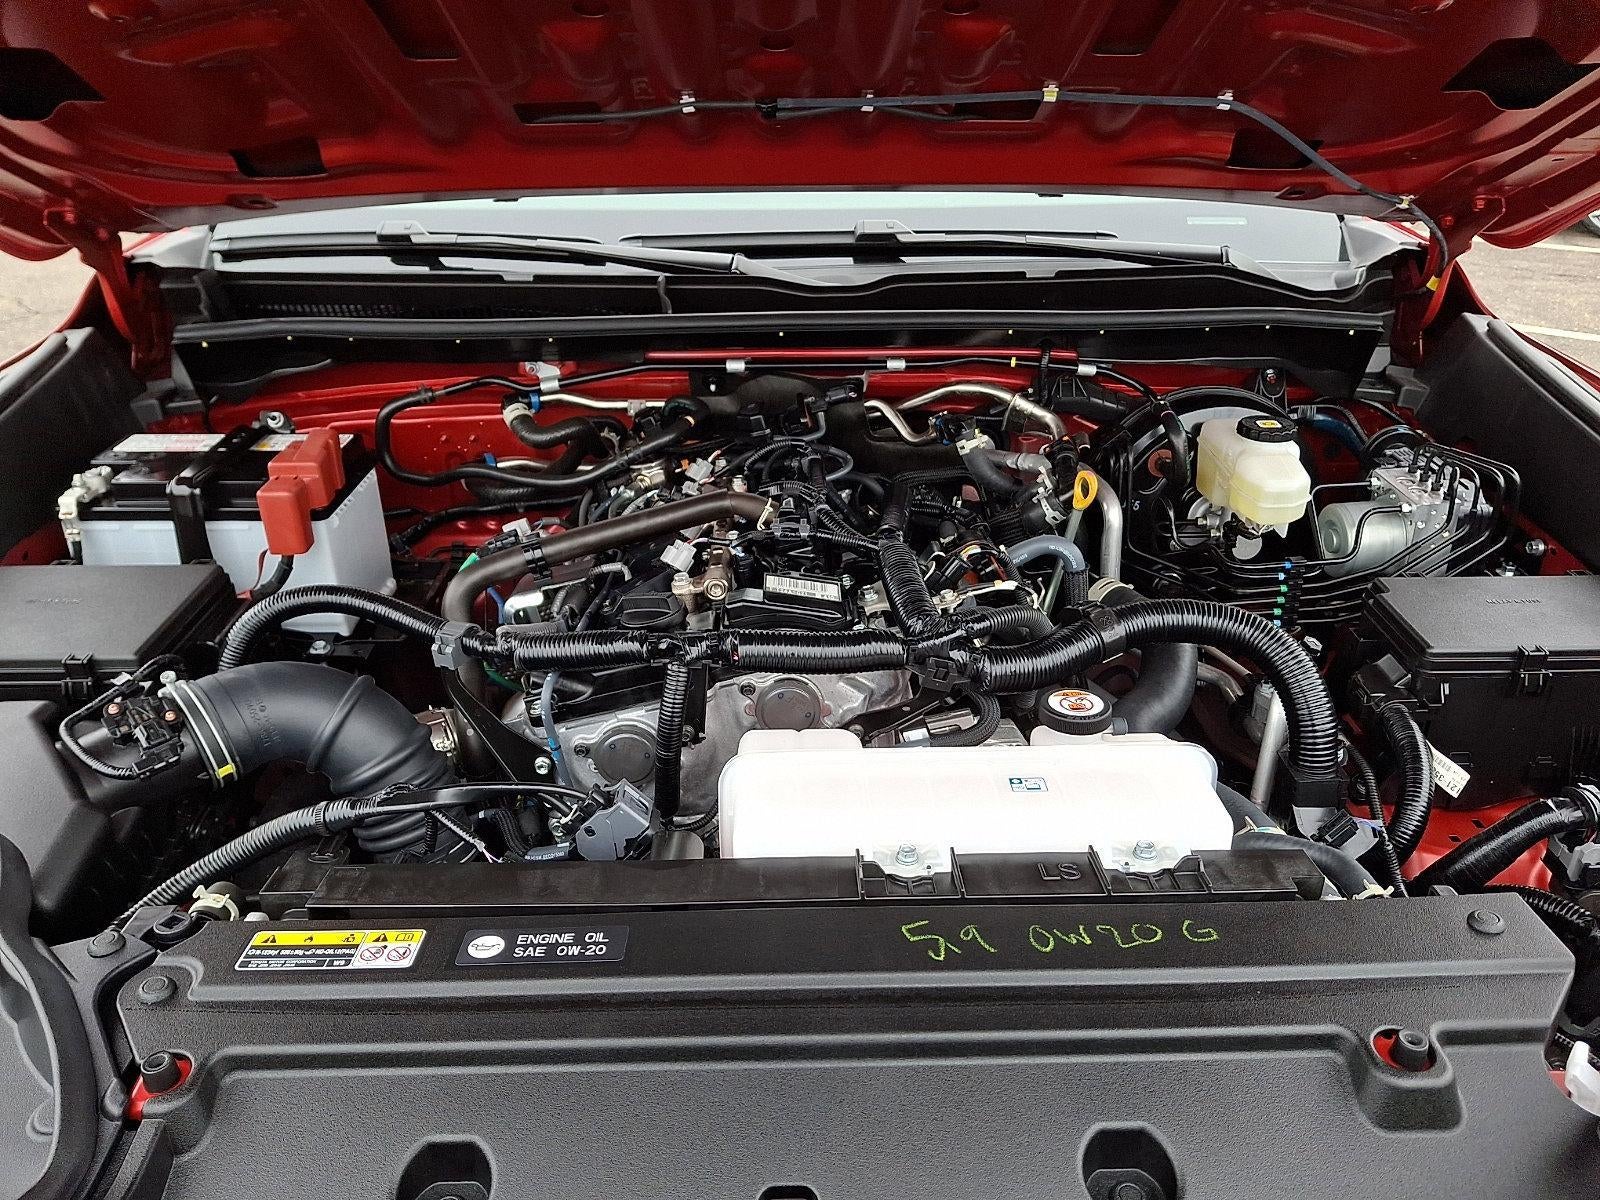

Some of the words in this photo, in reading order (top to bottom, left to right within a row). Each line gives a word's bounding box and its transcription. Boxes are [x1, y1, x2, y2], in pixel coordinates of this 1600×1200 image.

[1037, 862, 1081, 880] LS
[516, 933, 575, 944] ENGINE
[584, 931, 609, 942] OIL
[513, 946, 546, 957] SAE
[556, 944, 606, 956] 0W-20
